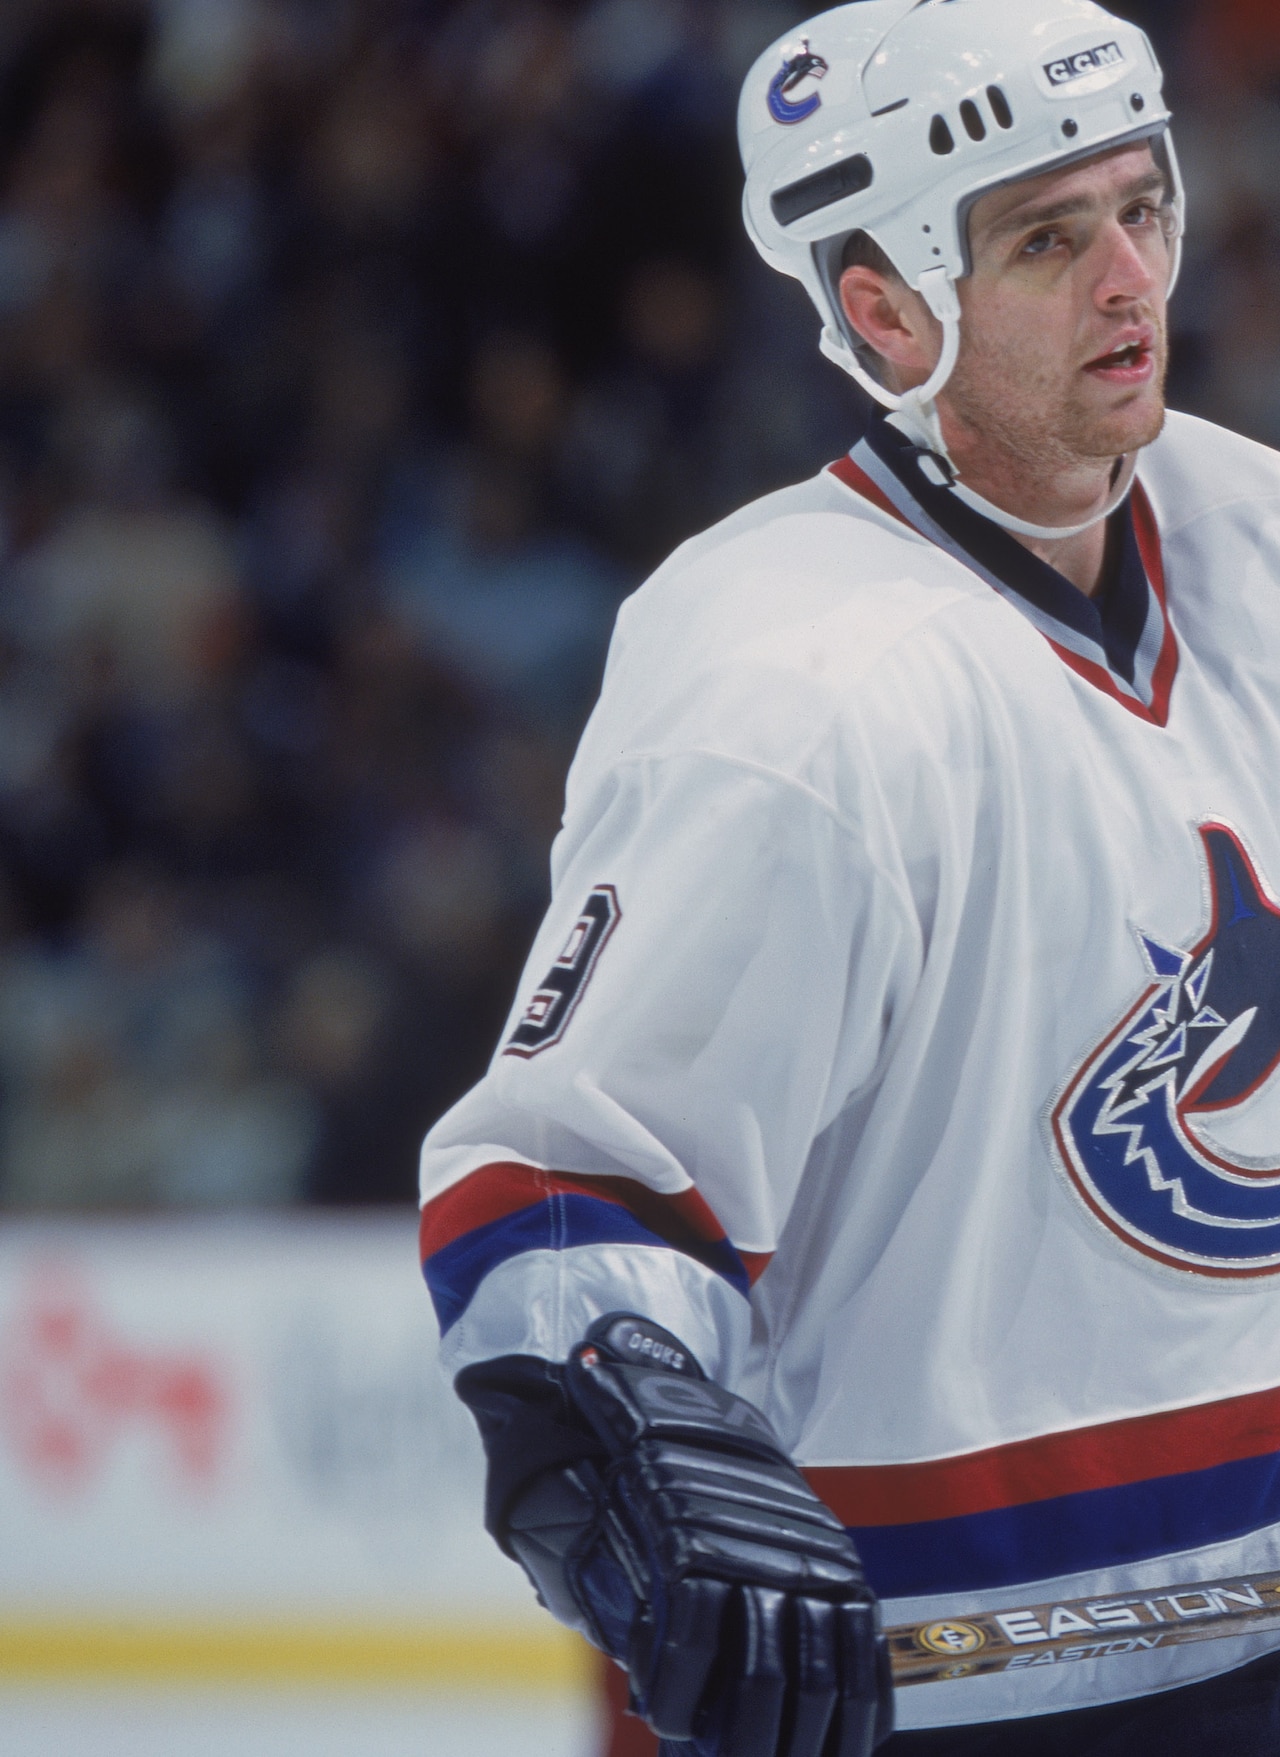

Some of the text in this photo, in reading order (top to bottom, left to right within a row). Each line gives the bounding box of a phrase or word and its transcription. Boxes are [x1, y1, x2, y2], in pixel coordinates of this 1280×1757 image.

[1046, 43, 1122, 84] CCM
[993, 1583, 1265, 1645] EASTON
[1004, 1633, 1165, 1671] EASTON
